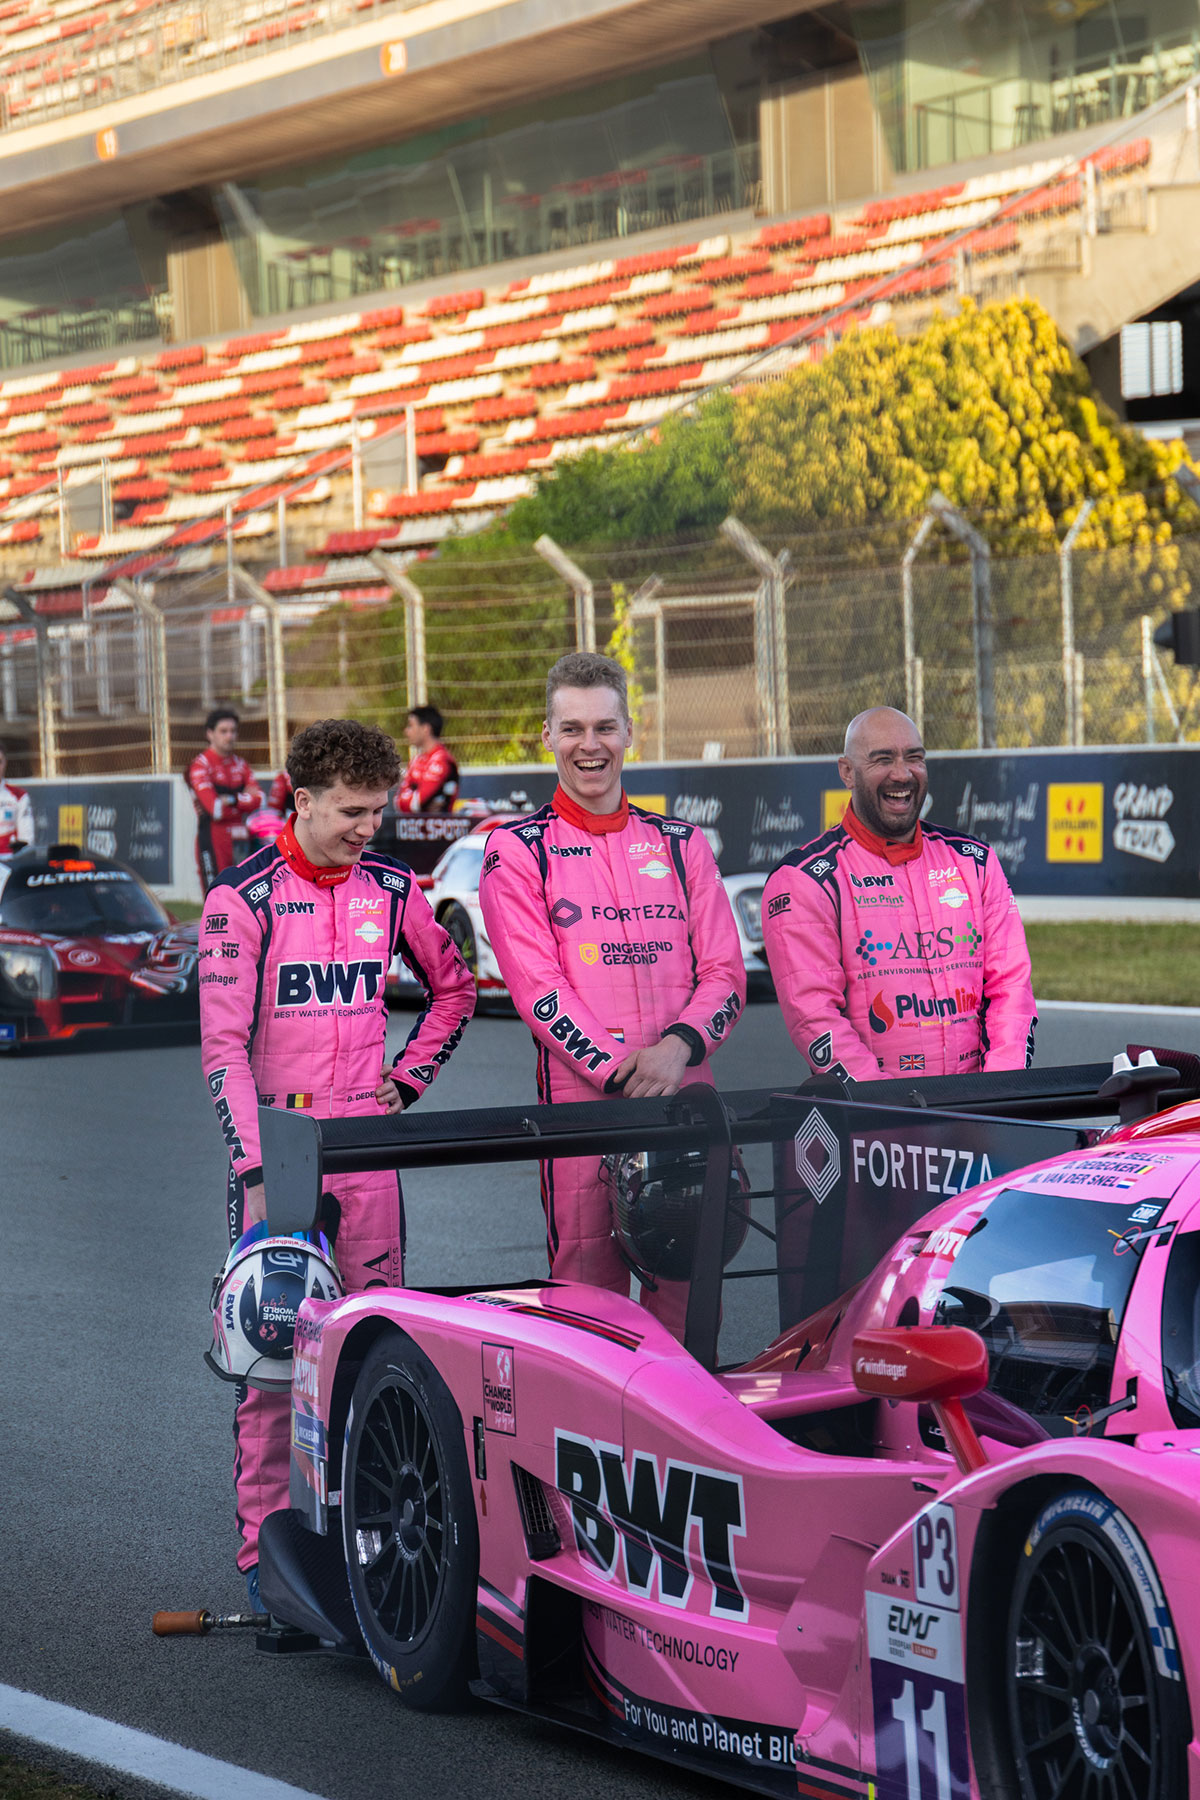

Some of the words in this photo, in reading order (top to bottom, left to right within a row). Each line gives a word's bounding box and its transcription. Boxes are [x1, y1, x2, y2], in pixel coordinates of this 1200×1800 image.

[1113, 782, 1173, 818] GRAND
[426, 818, 471, 840] SPORT
[662, 824, 687, 834] OMP
[1122, 827, 1164, 849] TOUR
[560, 846, 592, 857] BWT
[629, 842, 666, 853] ELMS
[961, 845, 984, 857] OMP
[484, 854, 500, 871] MP
[27, 871, 133, 887] ULTIMATE
[862, 875, 895, 888] BWT
[928, 866, 958, 880] ELMS
[383, 875, 405, 889] OMP
[249, 883, 270, 901] OMP
[854, 895, 878, 905] Viro
[879, 894, 905, 904] Print
[287, 901, 315, 915] BWT
[348, 898, 384, 910] ELMS
[767, 896, 791, 915] OMP
[591, 904, 687, 922] FORTEZZA
[205, 917, 228, 930] OMP
[601, 941, 673, 954] ONGEKEND
[889, 926, 955, 960] AES
[602, 953, 658, 966] GEZOND
[275, 959, 385, 1008] BWT
[857, 972, 877, 980] ABEL
[274, 1010, 296, 1019] BEST
[299, 1009, 328, 1018] WATER
[331, 1006, 377, 1017] TECHNOLOGY
[548, 1013, 614, 1073] BWT
[259, 1097, 277, 1107] MP
[356, 1092, 376, 1101] DEDE
[215, 1096, 248, 1163] BWT
[1124, 1152, 1158, 1162] BELL
[852, 1138, 994, 1196] FORTEZZA
[1075, 1161, 1139, 1174] DEDECKER
[229, 1169, 237, 1192] or
[1042, 1174, 1064, 1184] VAN
[1064, 1174, 1088, 1185] DER
[1087, 1175, 1120, 1187] SNEL
[228, 1199, 238, 1239] You
[1131, 1206, 1159, 1220] OMP
[922, 1231, 967, 1258] MOTU
[226, 1294, 235, 1330] BWT
[263, 1306, 294, 1315] WORLD
[864, 1357, 908, 1381] windhager
[484, 1383, 512, 1402] CHANGE
[491, 1400, 513, 1415] WORLD
[1040, 1496, 1106, 1528] MICHELIN
[554, 1427, 749, 1623] BWT
[916, 1512, 956, 1597] P3
[1130, 1552, 1153, 1592] SPORT
[888, 1605, 940, 1641] ELMS
[604, 1608, 636, 1643] WATER
[638, 1625, 739, 1673] TECHNOLOGY
[624, 1698, 642, 1727] For
[643, 1706, 668, 1737] You
[671, 1718, 699, 1745] and
[702, 1722, 763, 1760] Planet
[769, 1735, 797, 1765] Blu
[891, 1679, 952, 1800] 11
